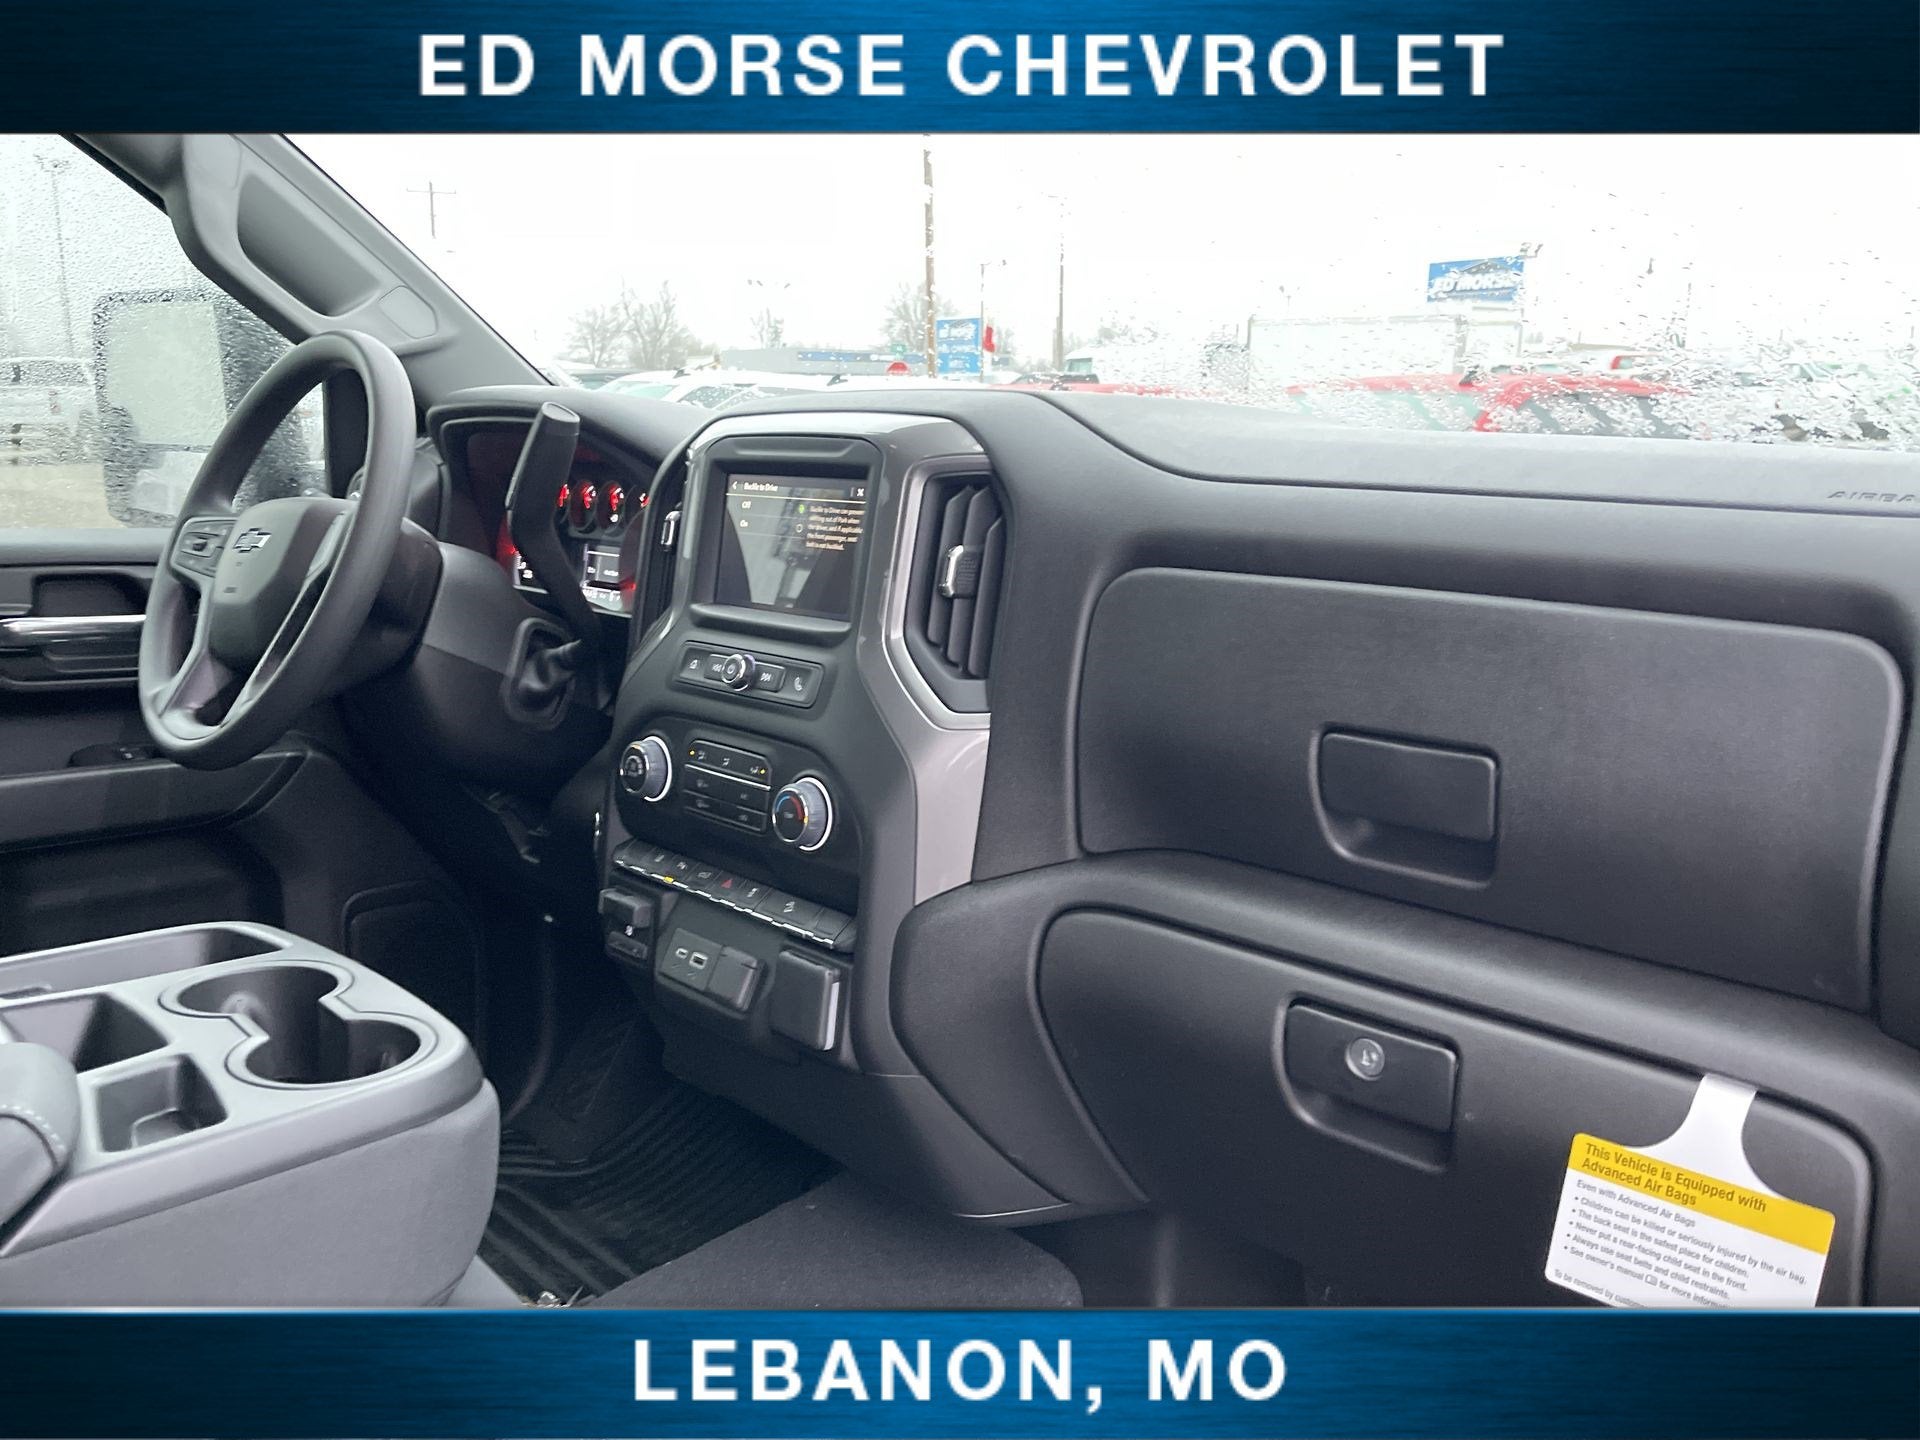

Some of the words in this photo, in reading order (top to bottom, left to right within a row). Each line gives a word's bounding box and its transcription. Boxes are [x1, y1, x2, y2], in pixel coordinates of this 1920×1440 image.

[1577, 1180, 1596, 1193] Even
[1598, 1189, 1617, 1200] with
[1618, 1194, 1659, 1214] Advanced
[1660, 1208, 1672, 1219] Air
[1675, 1213, 1696, 1227] Bags
[1582, 1158, 1642, 1186] Advanced
[1644, 1179, 1662, 1193] Air
[1666, 1186, 1697, 1205] Bags
[1585, 1143, 1610, 1161] This
[1613, 1152, 1658, 1177] Vehicle
[1661, 1168, 1672, 1181] is
[1675, 1172, 1735, 1202] Equipped
[1737, 1196, 1767, 1212] with
[1572, 1235, 1599, 1250] Always
[1601, 1247, 1614, 1256] use
[1616, 1252, 1632, 1262] seat
[1634, 1257, 1652, 1270] belts
[1654, 1267, 1669, 1276] and
[1670, 1273, 1690, 1284] child
[1691, 1280, 1730, 1299] restraints.
[1578, 1209, 1592, 1221] The
[1594, 1215, 1612, 1228] back
[1613, 1224, 1630, 1234] seat
[1631, 1228, 1638, 1238] is
[1639, 1231, 1652, 1243] the
[1654, 1239, 1678, 1252] safest
[1679, 1248, 1700, 1260] place
[1702, 1254, 1713, 1265] for
[1715, 1261, 1749, 1278] children.
[1581, 1197, 1612, 1214] Children
[1615, 1211, 1629, 1220] can
[1632, 1215, 1641, 1224] be
[1643, 1220, 1666, 1233] killed
[1678, 1234, 1715, 1252] seriously
[1717, 1246, 1746, 1261] injured
[1748, 1257, 1757, 1267] by
[1761, 1261, 1774, 1271] the
[1776, 1268, 1787, 1276] air
[1789, 1272, 1807, 1284] bag.
